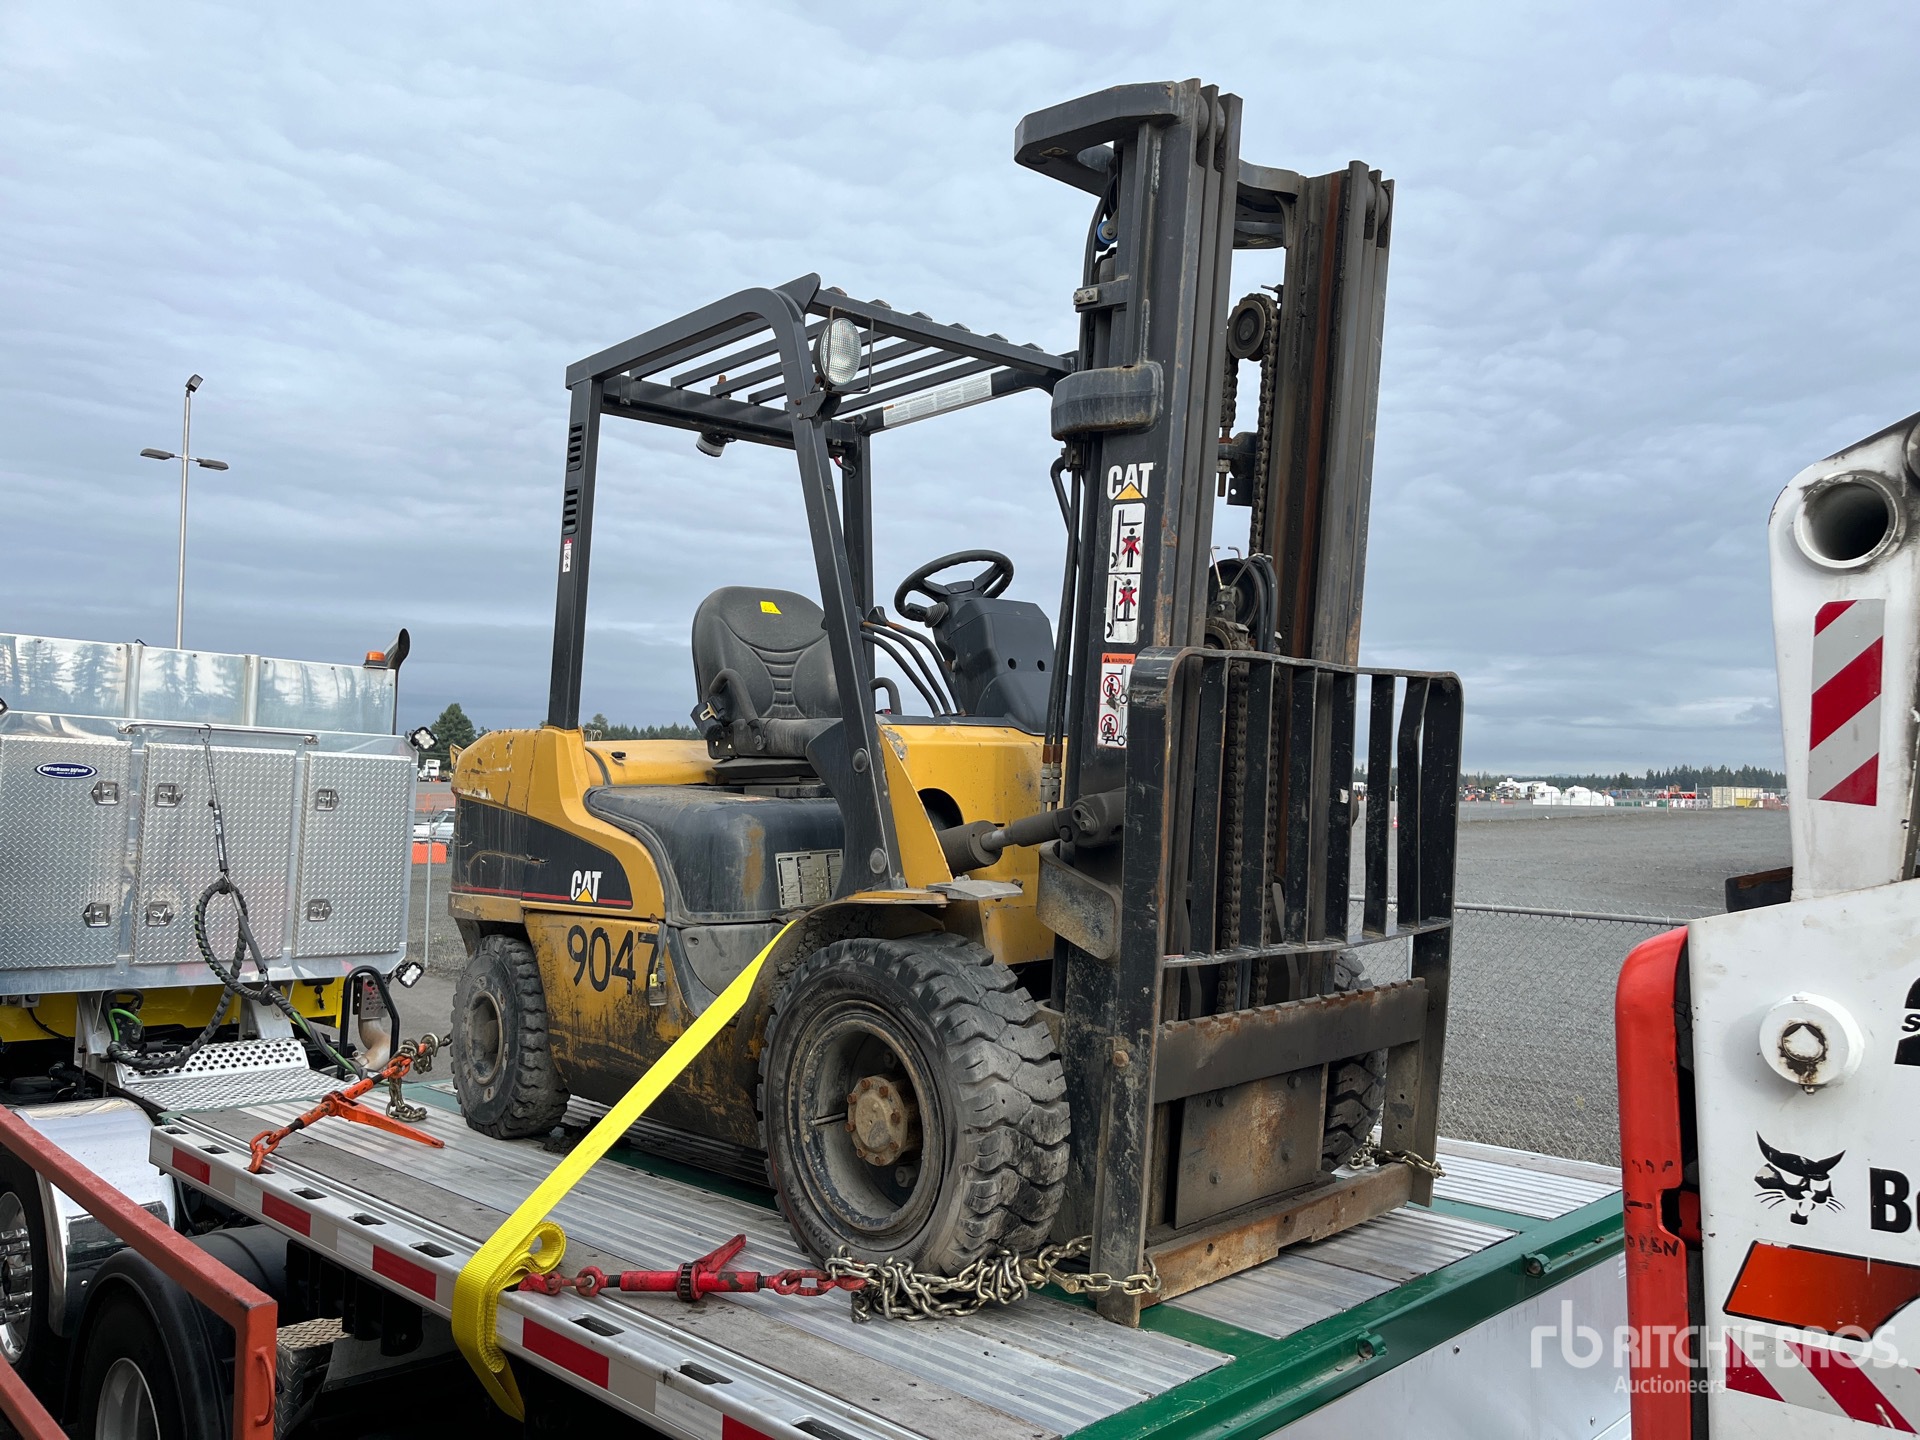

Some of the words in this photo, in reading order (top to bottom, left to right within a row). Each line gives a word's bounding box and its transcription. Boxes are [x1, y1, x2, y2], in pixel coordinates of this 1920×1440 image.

[1107, 462, 1154, 500] CAT
[570, 870, 602, 903] CAT
[567, 925, 659, 995] 9047
[1869, 1167, 1920, 1233] B
